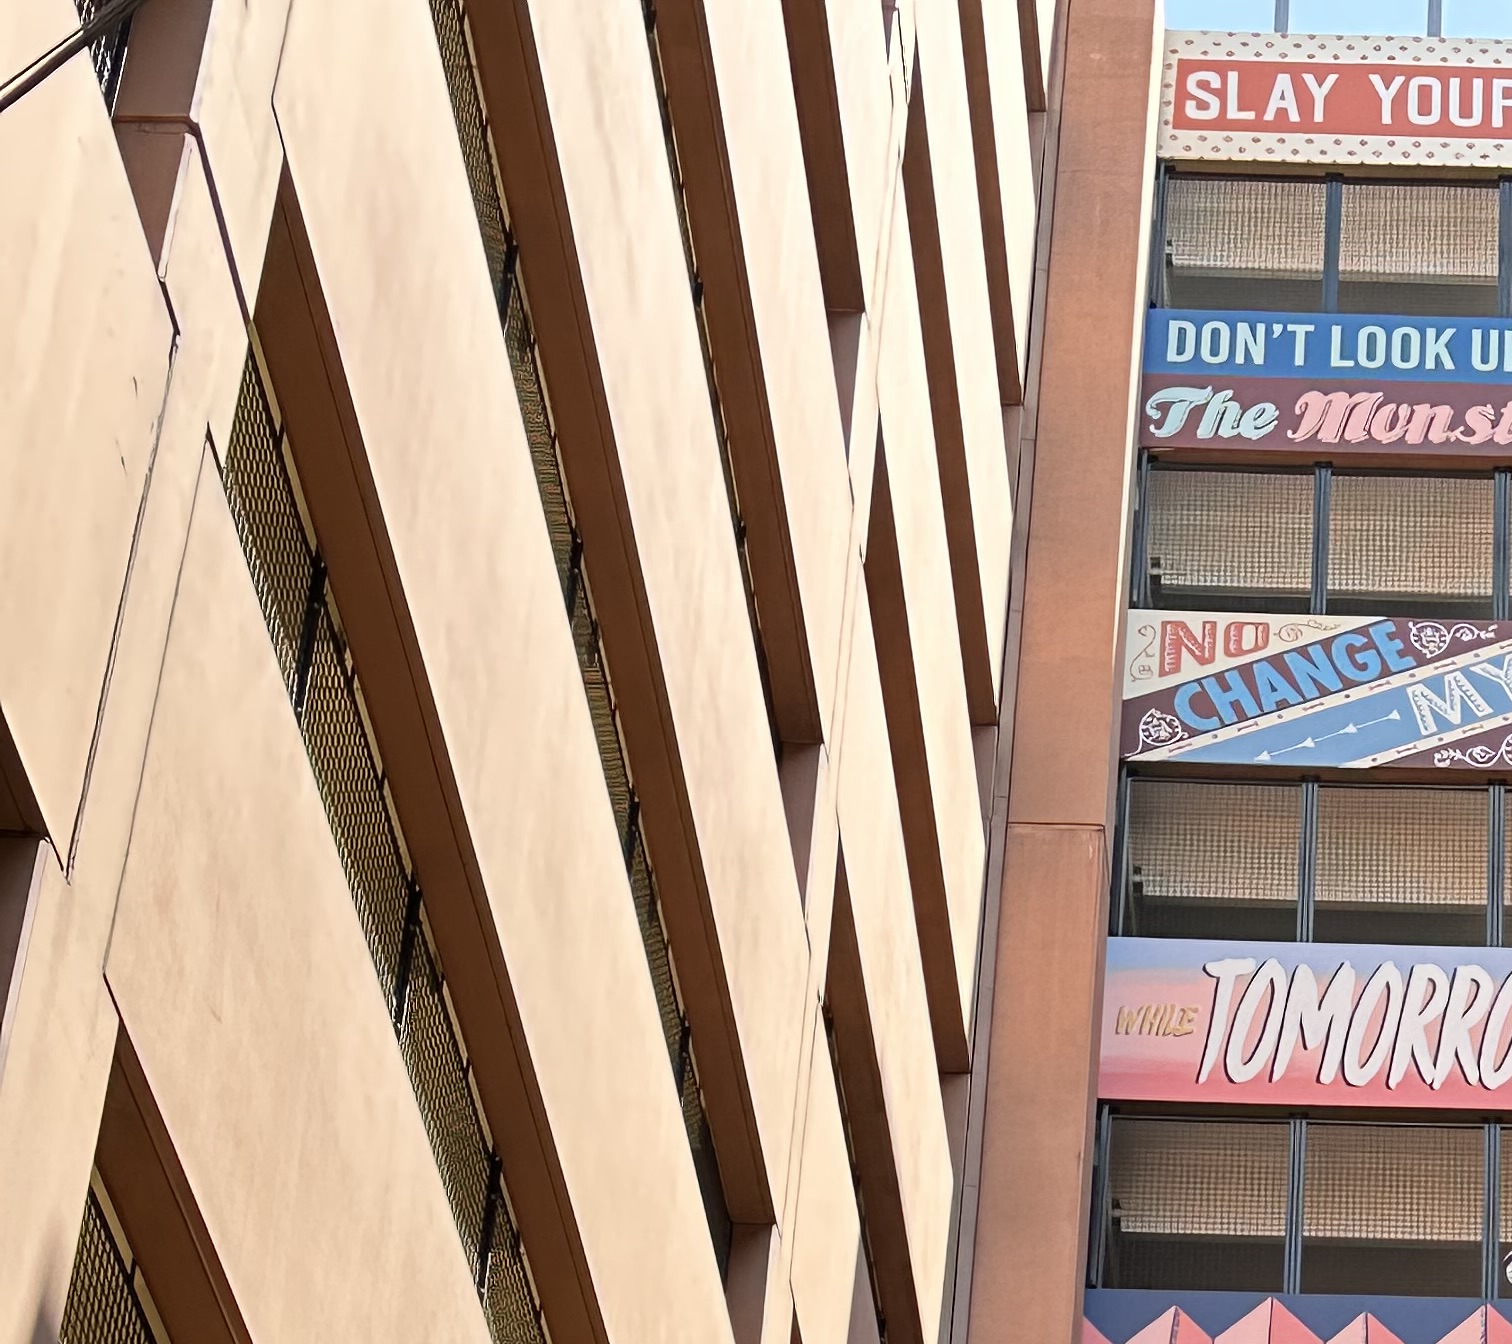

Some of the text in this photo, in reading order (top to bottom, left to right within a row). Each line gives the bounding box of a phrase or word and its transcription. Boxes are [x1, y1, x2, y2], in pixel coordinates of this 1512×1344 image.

[1185, 71, 1339, 125] SLAY
[1166, 319, 1315, 367] DON'T
[1329, 324, 1455, 372] LOOK
[1146, 386, 1280, 442] The
[1158, 620, 1270, 677] NO
[1174, 621, 1417, 731] CHANGE
[1115, 1003, 1199, 1037] WHILE
